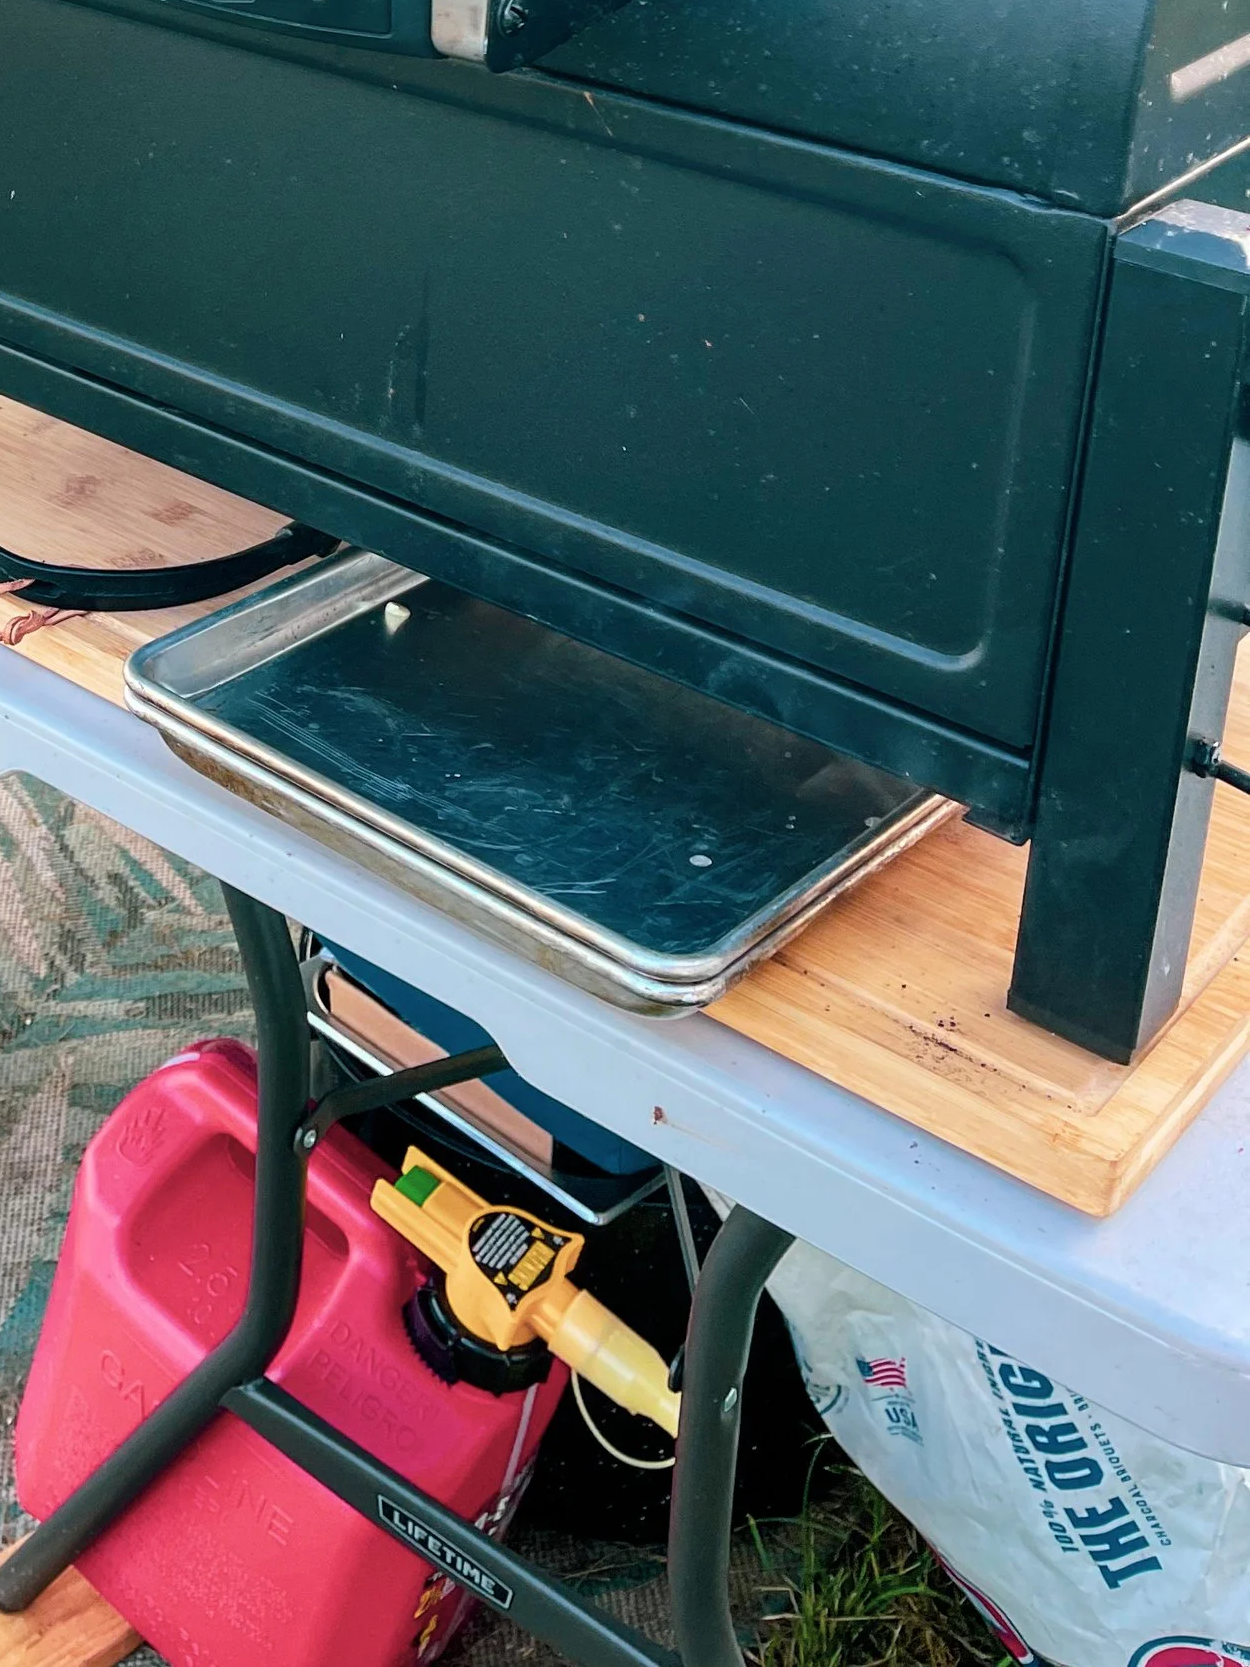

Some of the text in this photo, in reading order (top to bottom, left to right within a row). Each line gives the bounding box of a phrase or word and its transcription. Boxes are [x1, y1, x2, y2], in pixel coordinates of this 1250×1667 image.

[988, 1344, 1163, 1589] THE ORIG
[999, 1406, 1048, 1492] NATURAL
[1090, 1422, 1132, 1482] BRIQUETS
[393, 1510, 496, 1595] LIFETIME
[1128, 1483, 1172, 1546] CHARCOAL
